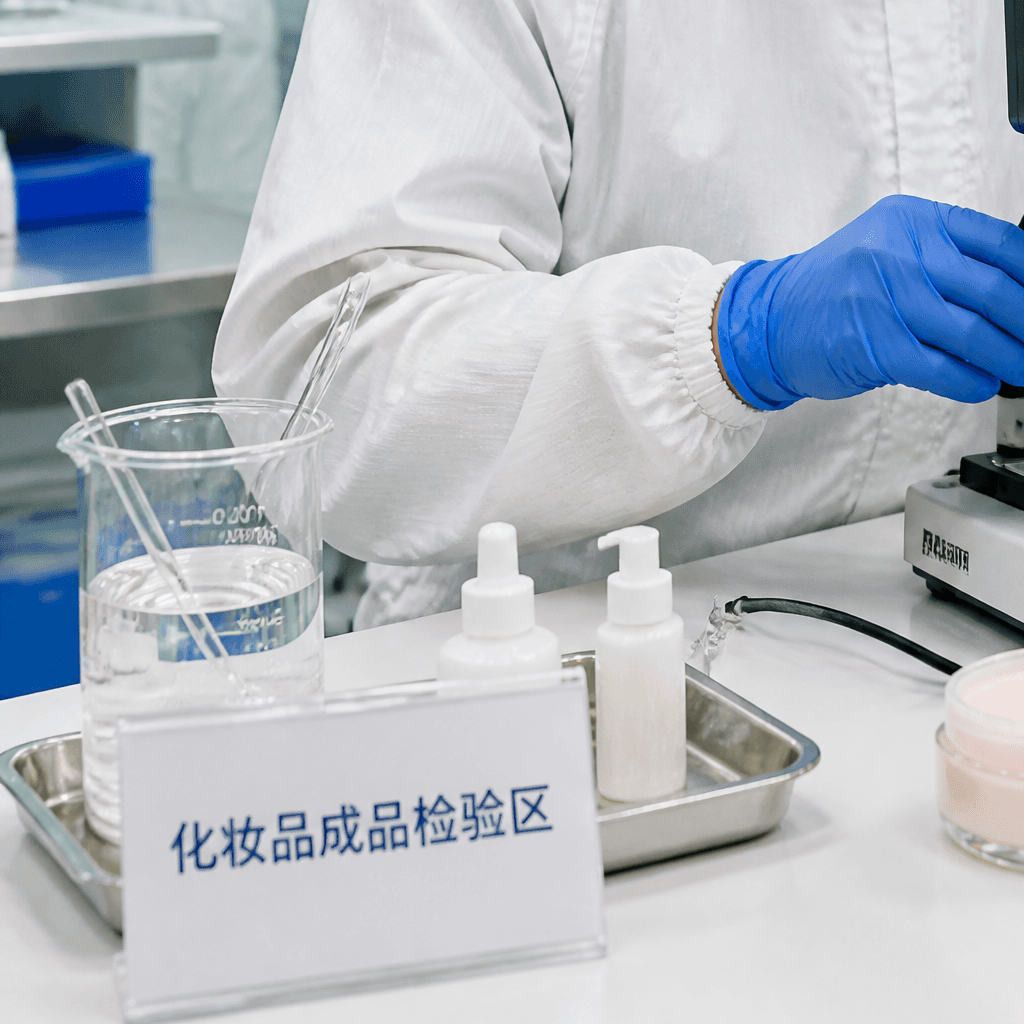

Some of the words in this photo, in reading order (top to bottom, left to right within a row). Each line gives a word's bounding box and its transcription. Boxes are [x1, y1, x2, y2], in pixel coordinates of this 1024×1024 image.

[170, 785, 554, 875] 化妆品成品检验区
